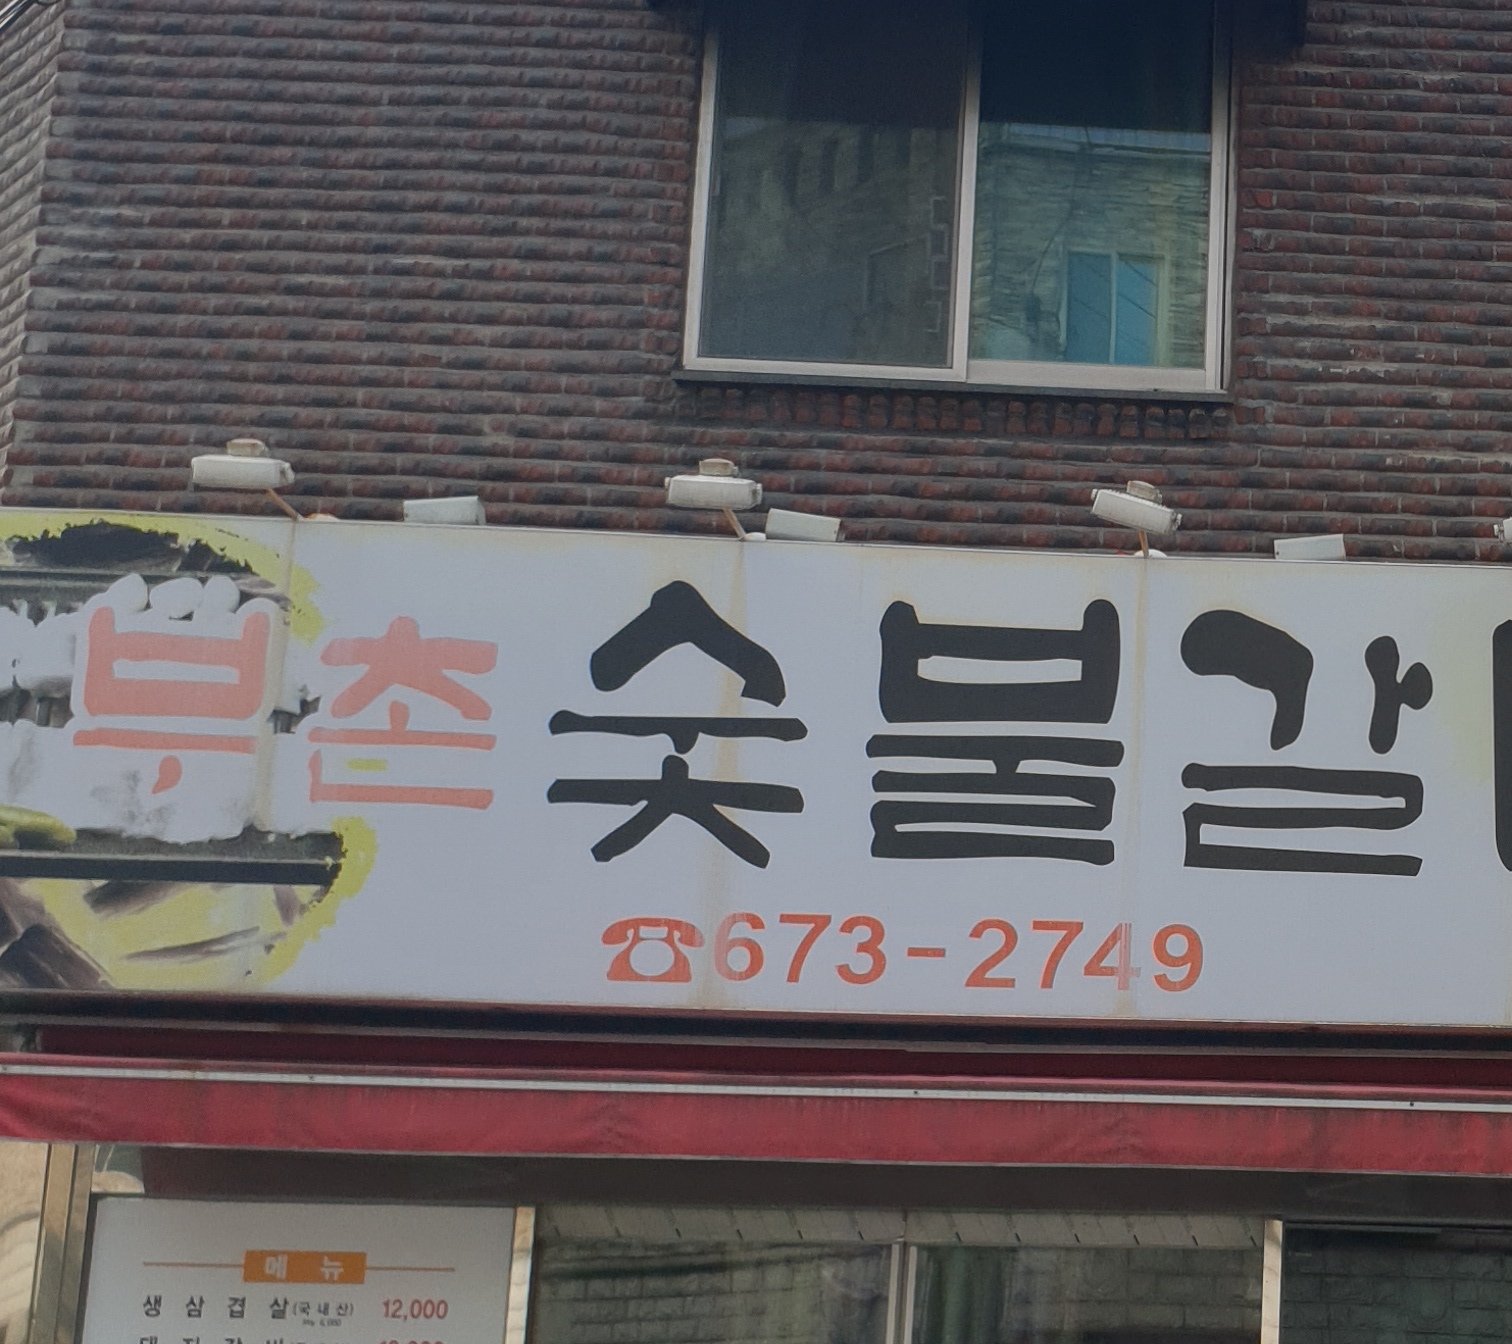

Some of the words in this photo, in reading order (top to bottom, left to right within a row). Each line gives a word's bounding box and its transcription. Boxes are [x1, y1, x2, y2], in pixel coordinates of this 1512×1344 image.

[74, 607, 497, 809] 부촌
[714, 912, 1204, 993] 673-2749
[382, 1299, 448, 1320] 12,000
